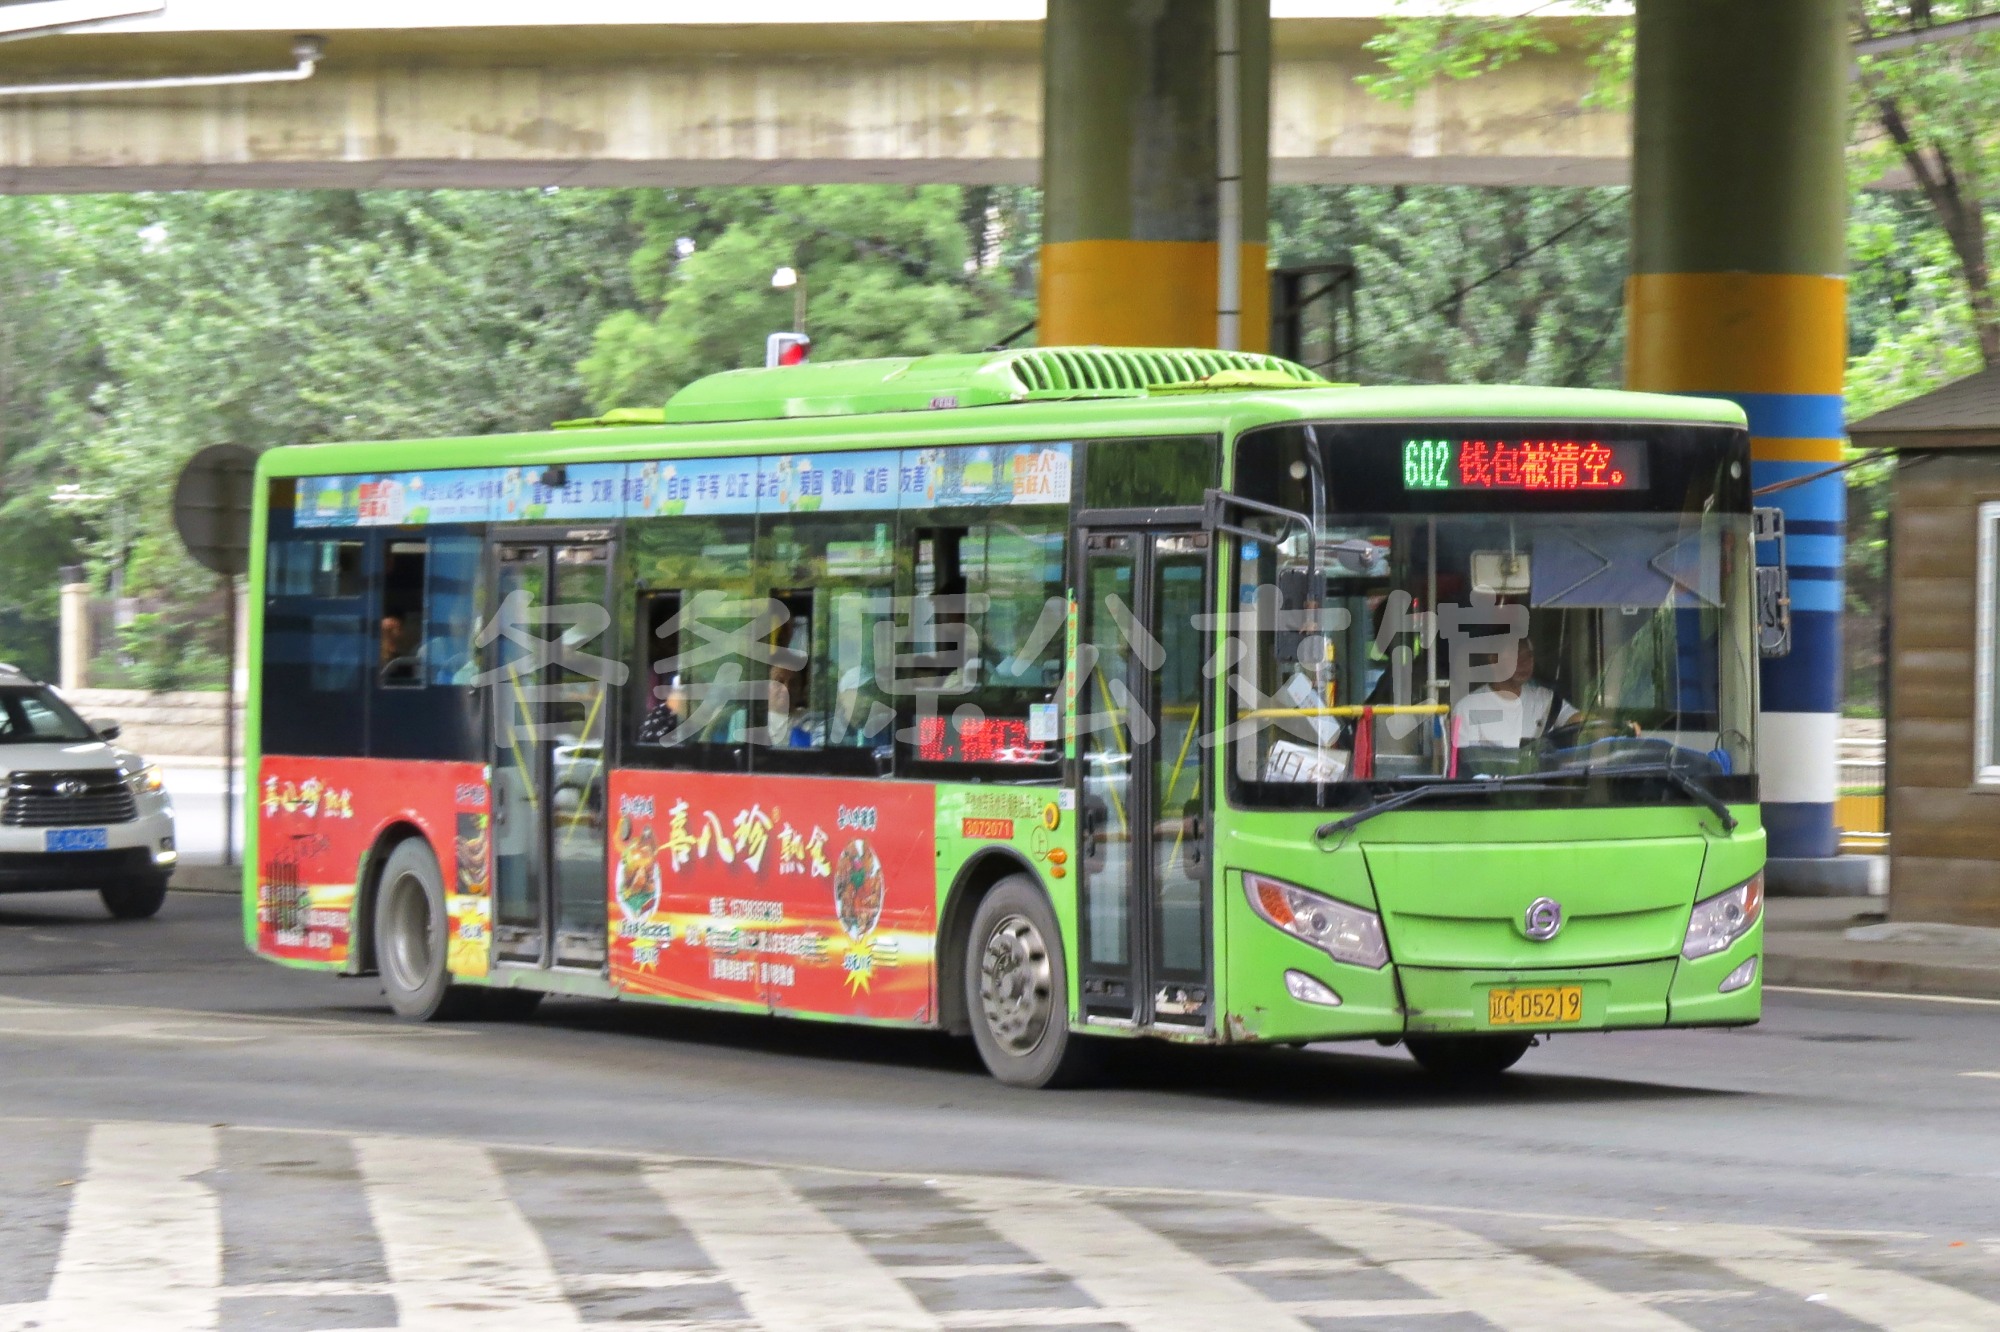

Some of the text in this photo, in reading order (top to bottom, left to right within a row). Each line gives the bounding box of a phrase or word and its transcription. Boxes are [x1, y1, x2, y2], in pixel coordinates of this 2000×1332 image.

[1404, 440, 1624, 488] 602 钱包被清空。
[668, 475, 690, 500] 自由
[696, 474, 720, 500] 平等
[726, 473, 749, 498] 公正
[800, 469, 824, 495] 爱国
[832, 468, 855, 495] 敬业
[863, 466, 888, 493] 诚信
[900, 465, 926, 492] 友善
[965, 821, 1010, 836] 3072071
